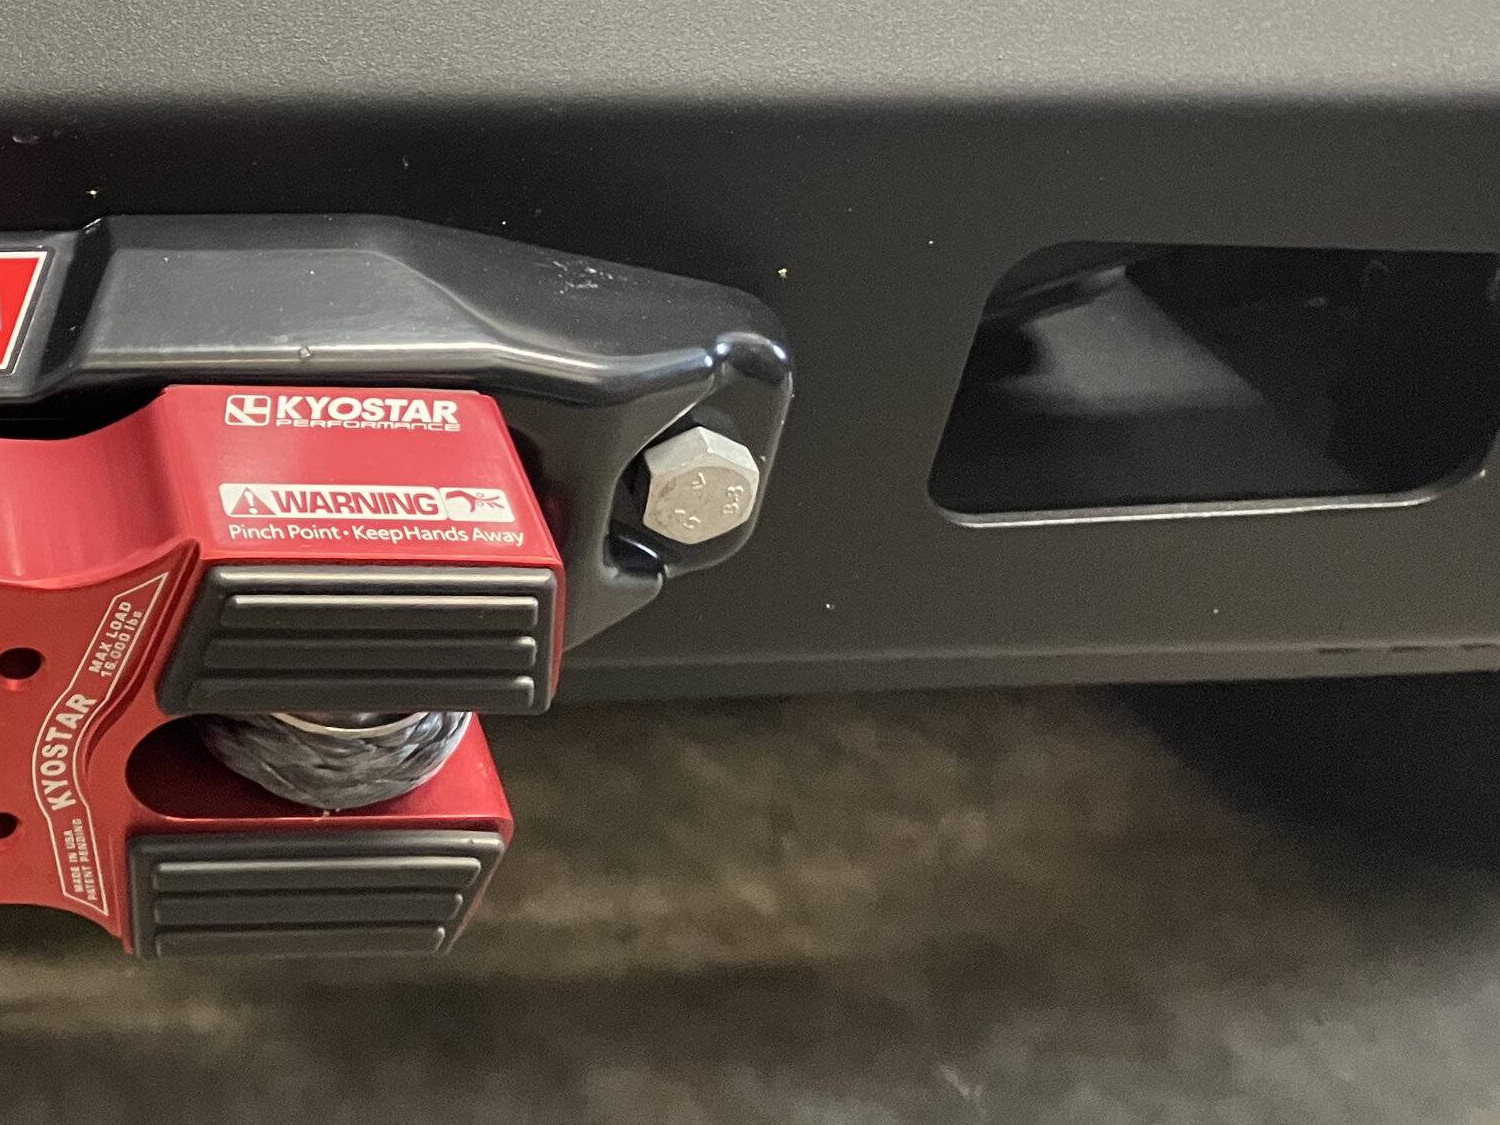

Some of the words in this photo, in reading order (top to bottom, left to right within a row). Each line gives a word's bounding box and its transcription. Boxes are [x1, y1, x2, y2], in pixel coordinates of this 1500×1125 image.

[275, 395, 458, 424] KYOSTAR
[275, 418, 461, 432] PERFORMANCE
[271, 489, 439, 515] WARNING
[228, 524, 284, 540] Pinch
[287, 525, 341, 540] Point
[352, 525, 403, 544] Keep
[404, 526, 469, 541] Hands
[472, 528, 524, 547] Away
[88, 641, 112, 673] MAX
[105, 601, 131, 639] LOAD
[40, 693, 98, 811] KYOSTAR
[63, 830, 76, 849] USA
[72, 818, 90, 863] PENDING
[68, 852, 78, 863] IN
[70, 866, 84, 892] MADE
[81, 865, 97, 901] PATENT
